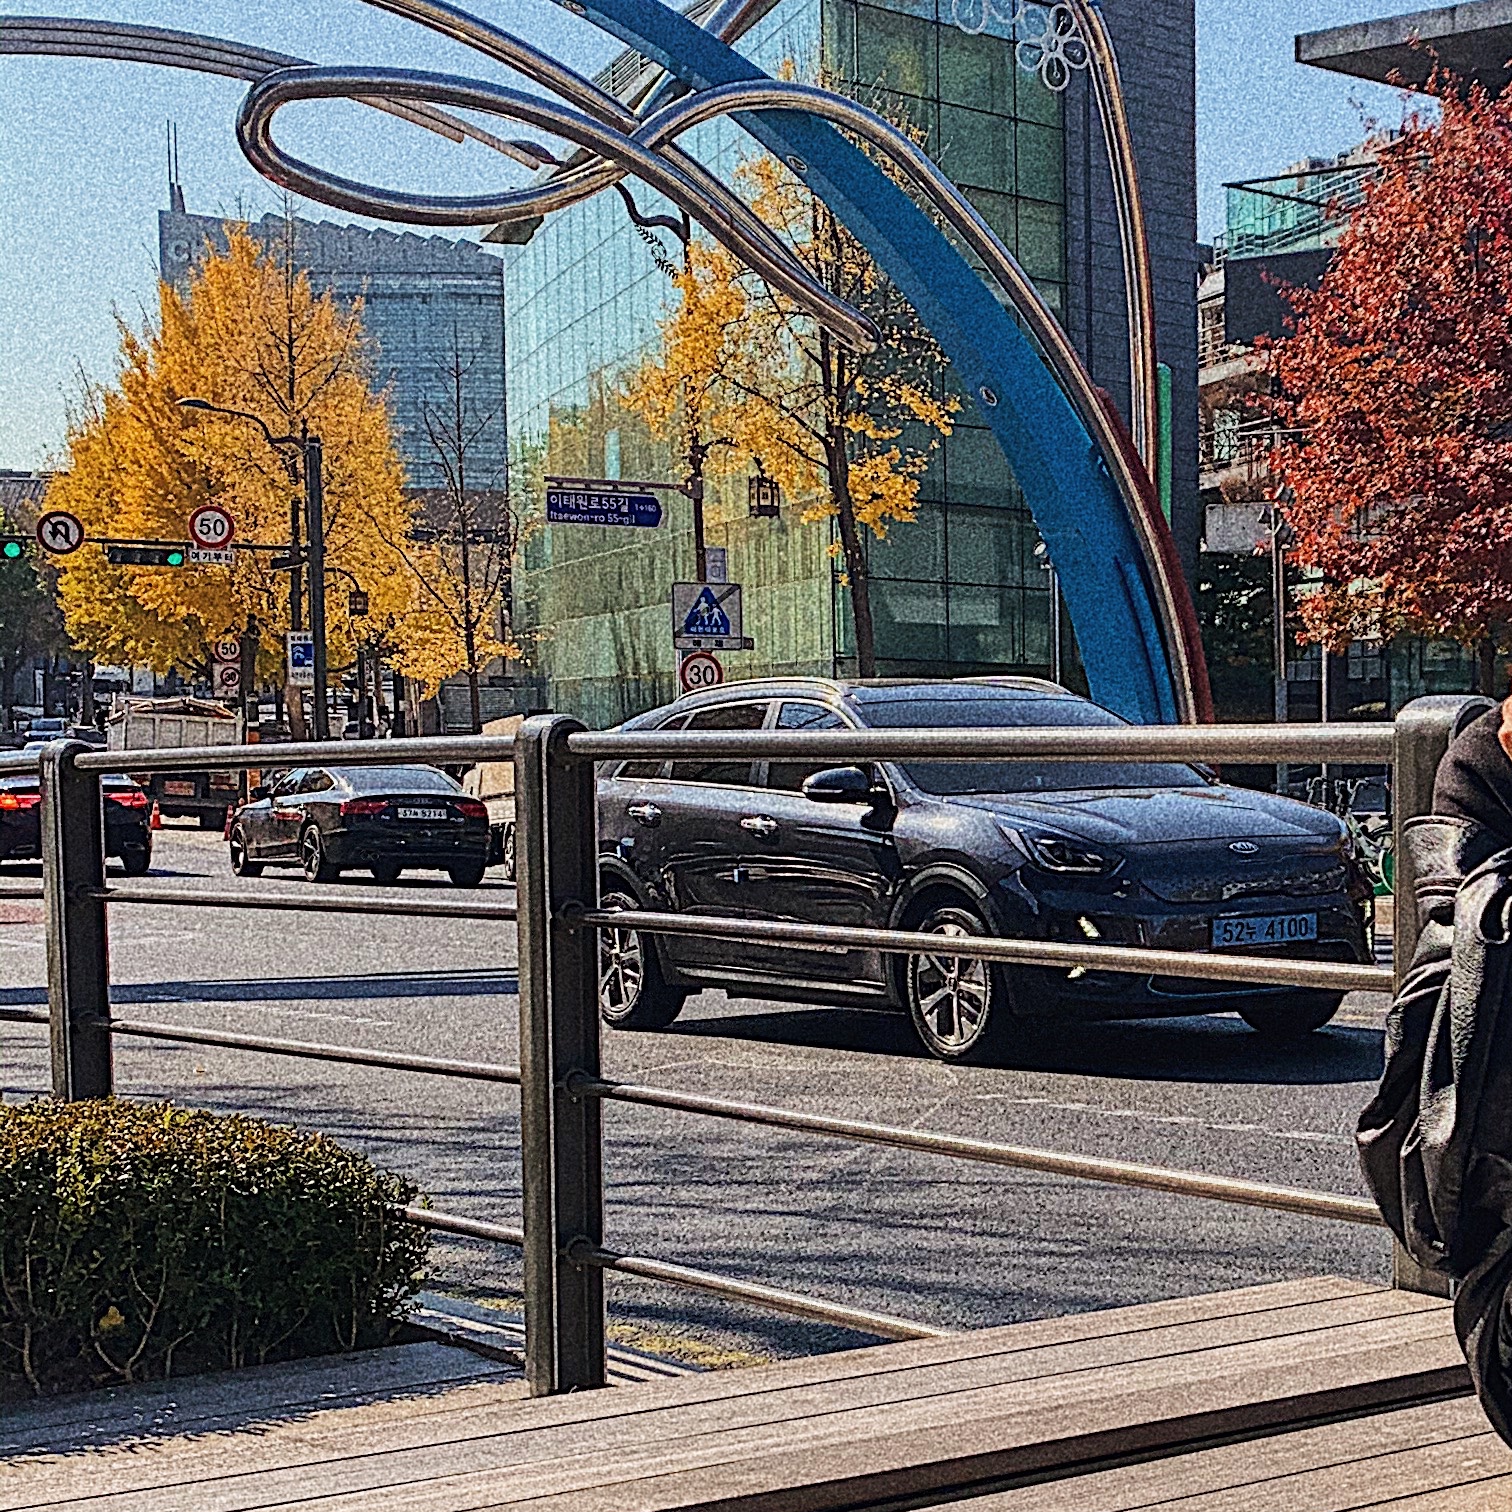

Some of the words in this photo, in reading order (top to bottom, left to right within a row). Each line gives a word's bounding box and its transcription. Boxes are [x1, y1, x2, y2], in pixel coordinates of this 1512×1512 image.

[550, 493, 629, 513] 이태원로55길
[199, 518, 225, 536] 50
[191, 551, 233, 562] 여기부터
[221, 642, 237, 655] 50
[689, 665, 715, 685] 30
[1222, 921, 1257, 943] 52누
[1264, 916, 1309, 940] 4100
